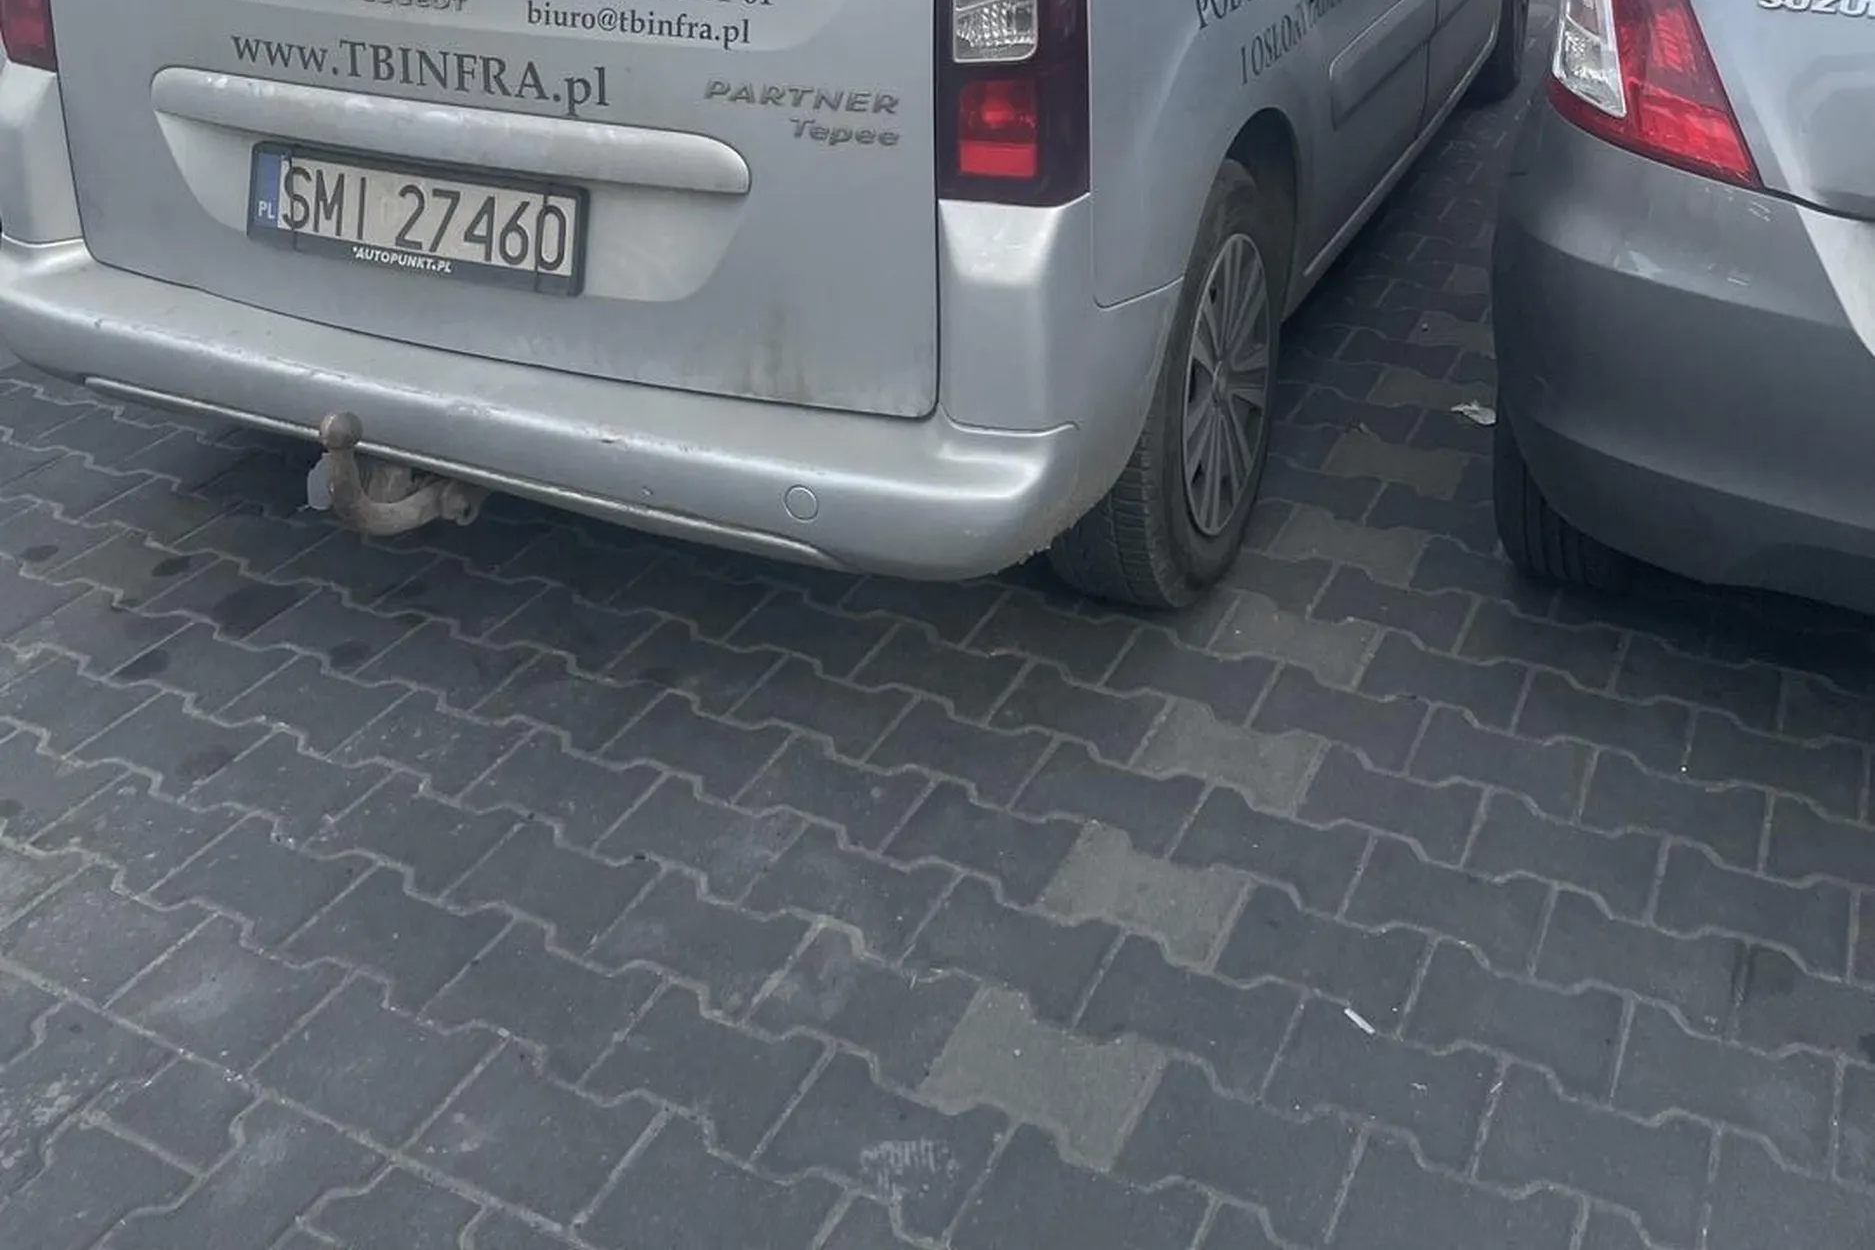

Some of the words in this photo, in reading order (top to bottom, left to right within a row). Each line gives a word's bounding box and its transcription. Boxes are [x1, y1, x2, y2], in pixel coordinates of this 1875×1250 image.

[527, 0, 751, 50] biuro@tbinfra.pl
[231, 35, 611, 117] www.TBINFRA.pl
[703, 78, 901, 116] PARTNER
[789, 116, 900, 147] Tepee
[257, 200, 276, 220] PL
[281, 165, 367, 241] SMI
[394, 183, 568, 272] 27460
